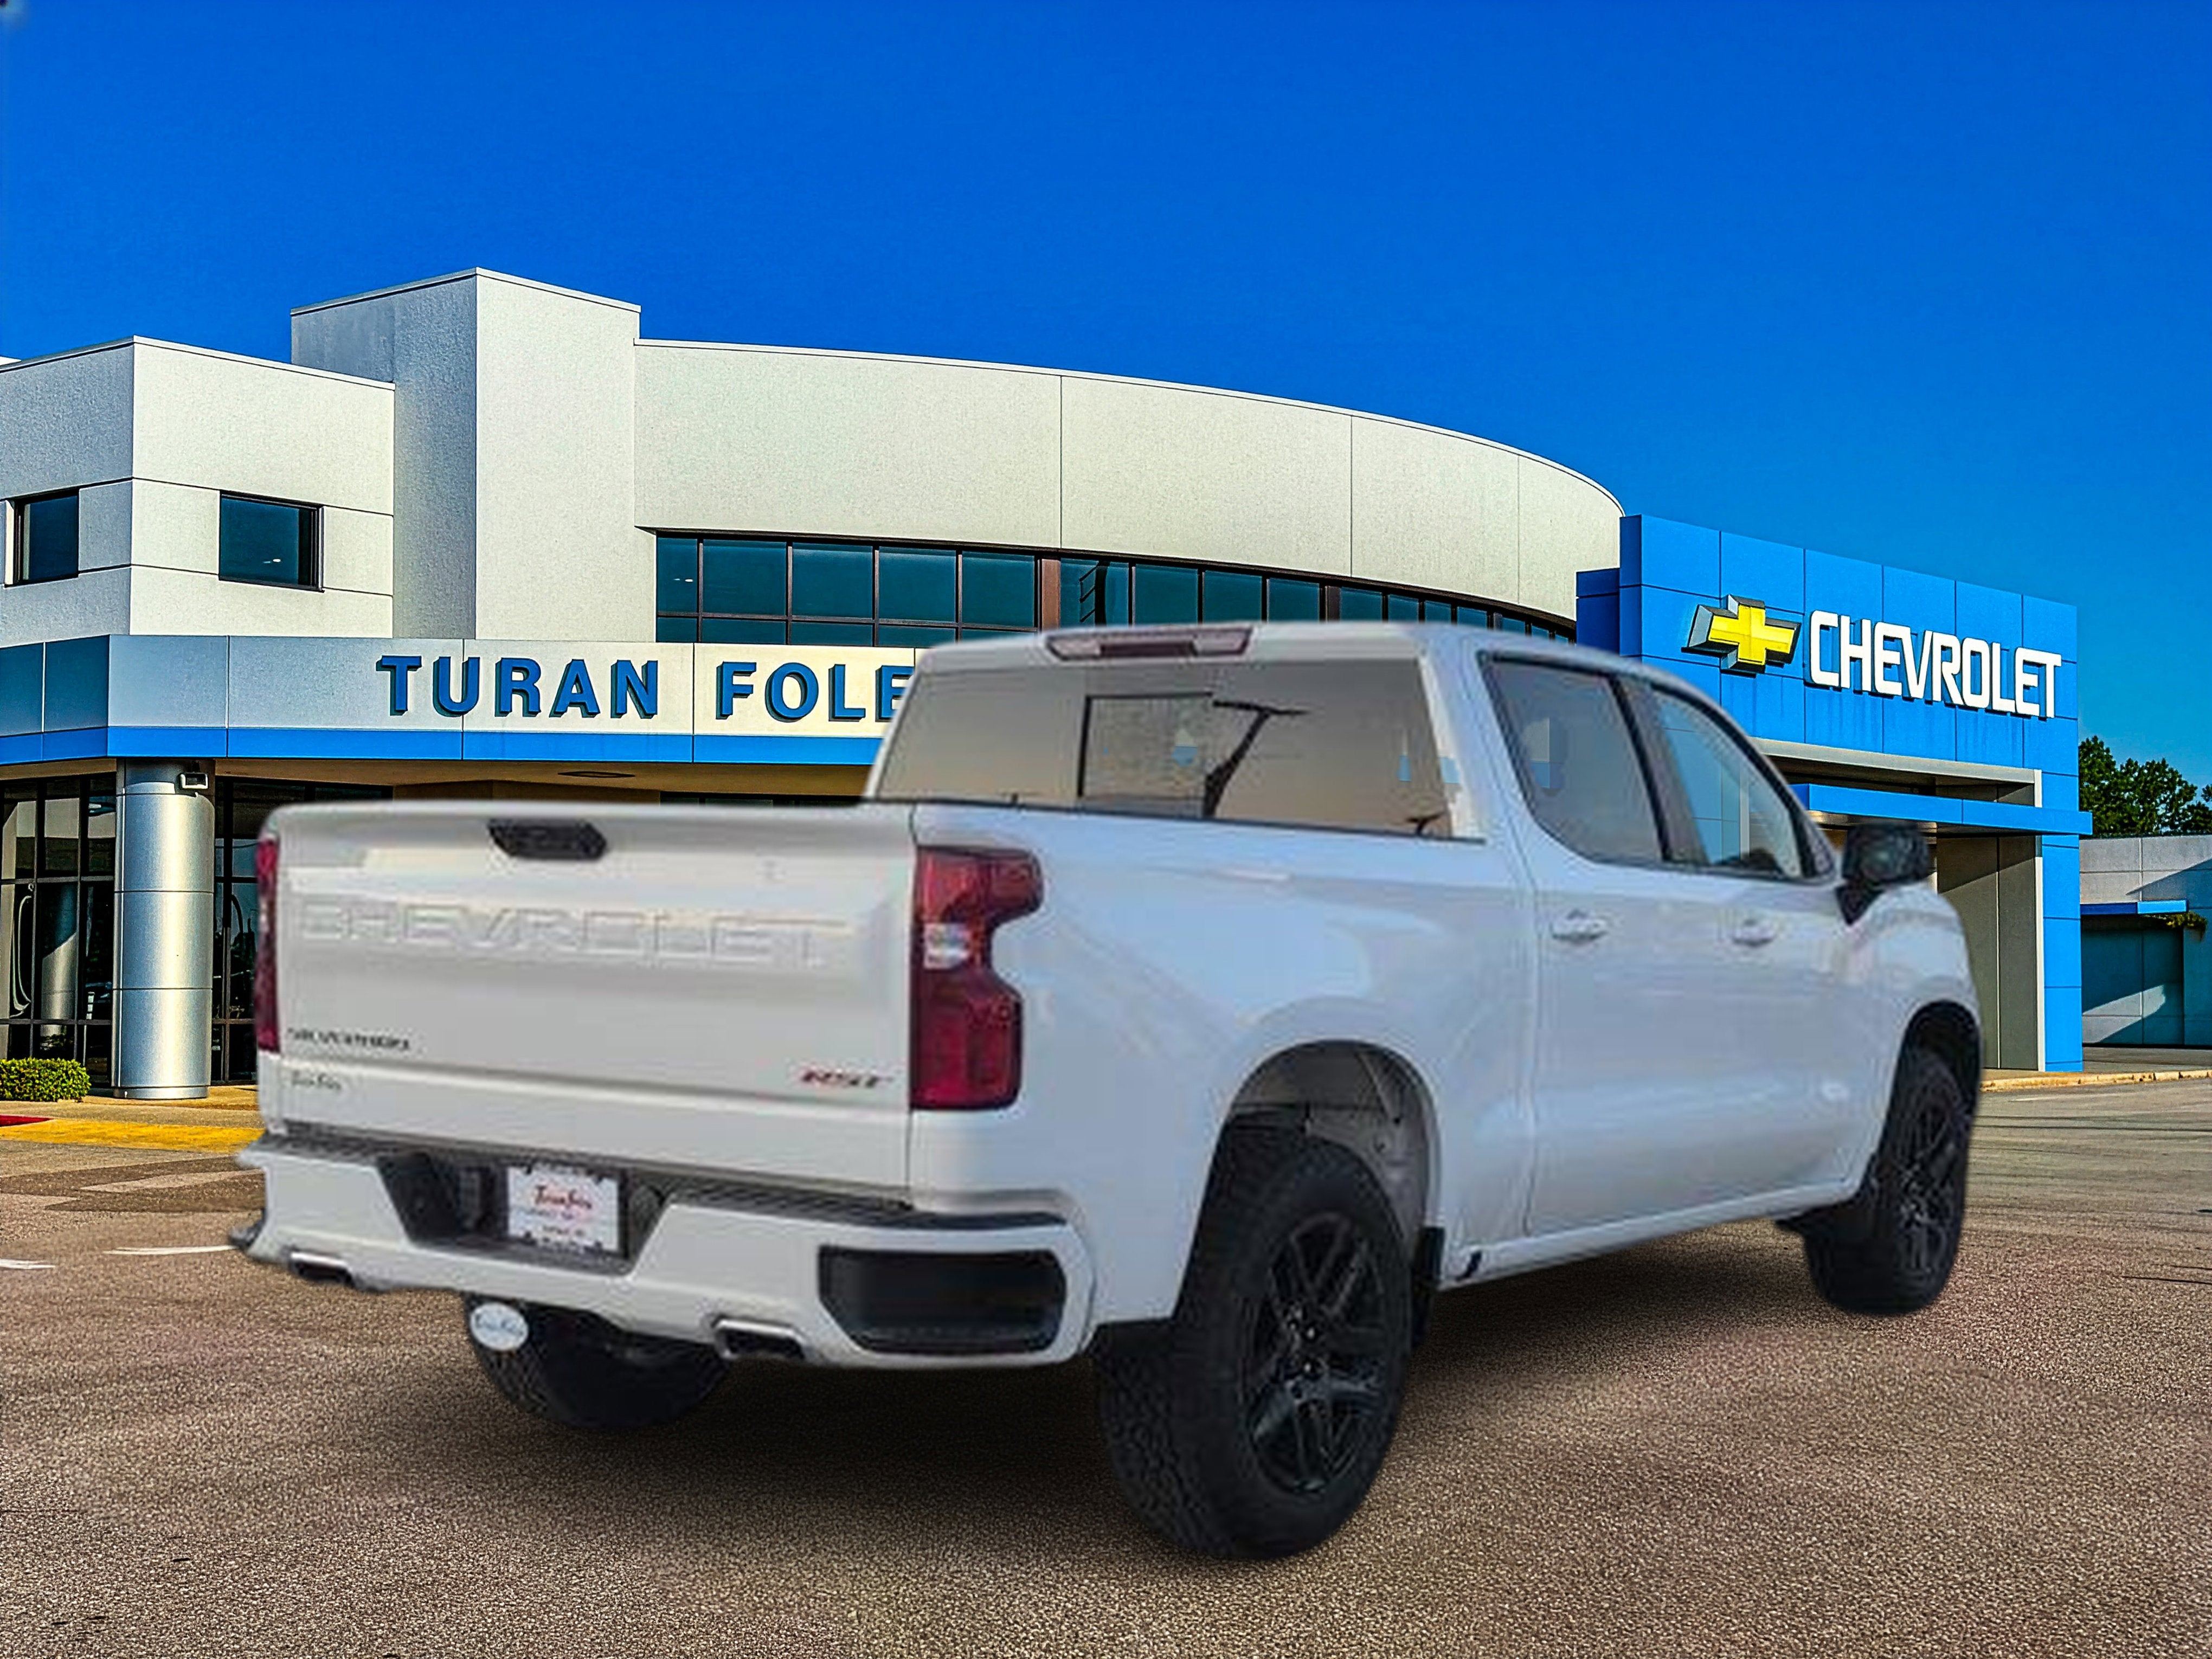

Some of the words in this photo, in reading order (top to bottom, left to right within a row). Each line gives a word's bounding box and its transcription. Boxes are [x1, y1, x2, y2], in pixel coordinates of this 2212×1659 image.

[376, 654, 659, 719] TURAN
[1810, 609, 2062, 719] CHEVROLET
[301, 895, 850, 967] CHEVROLET
